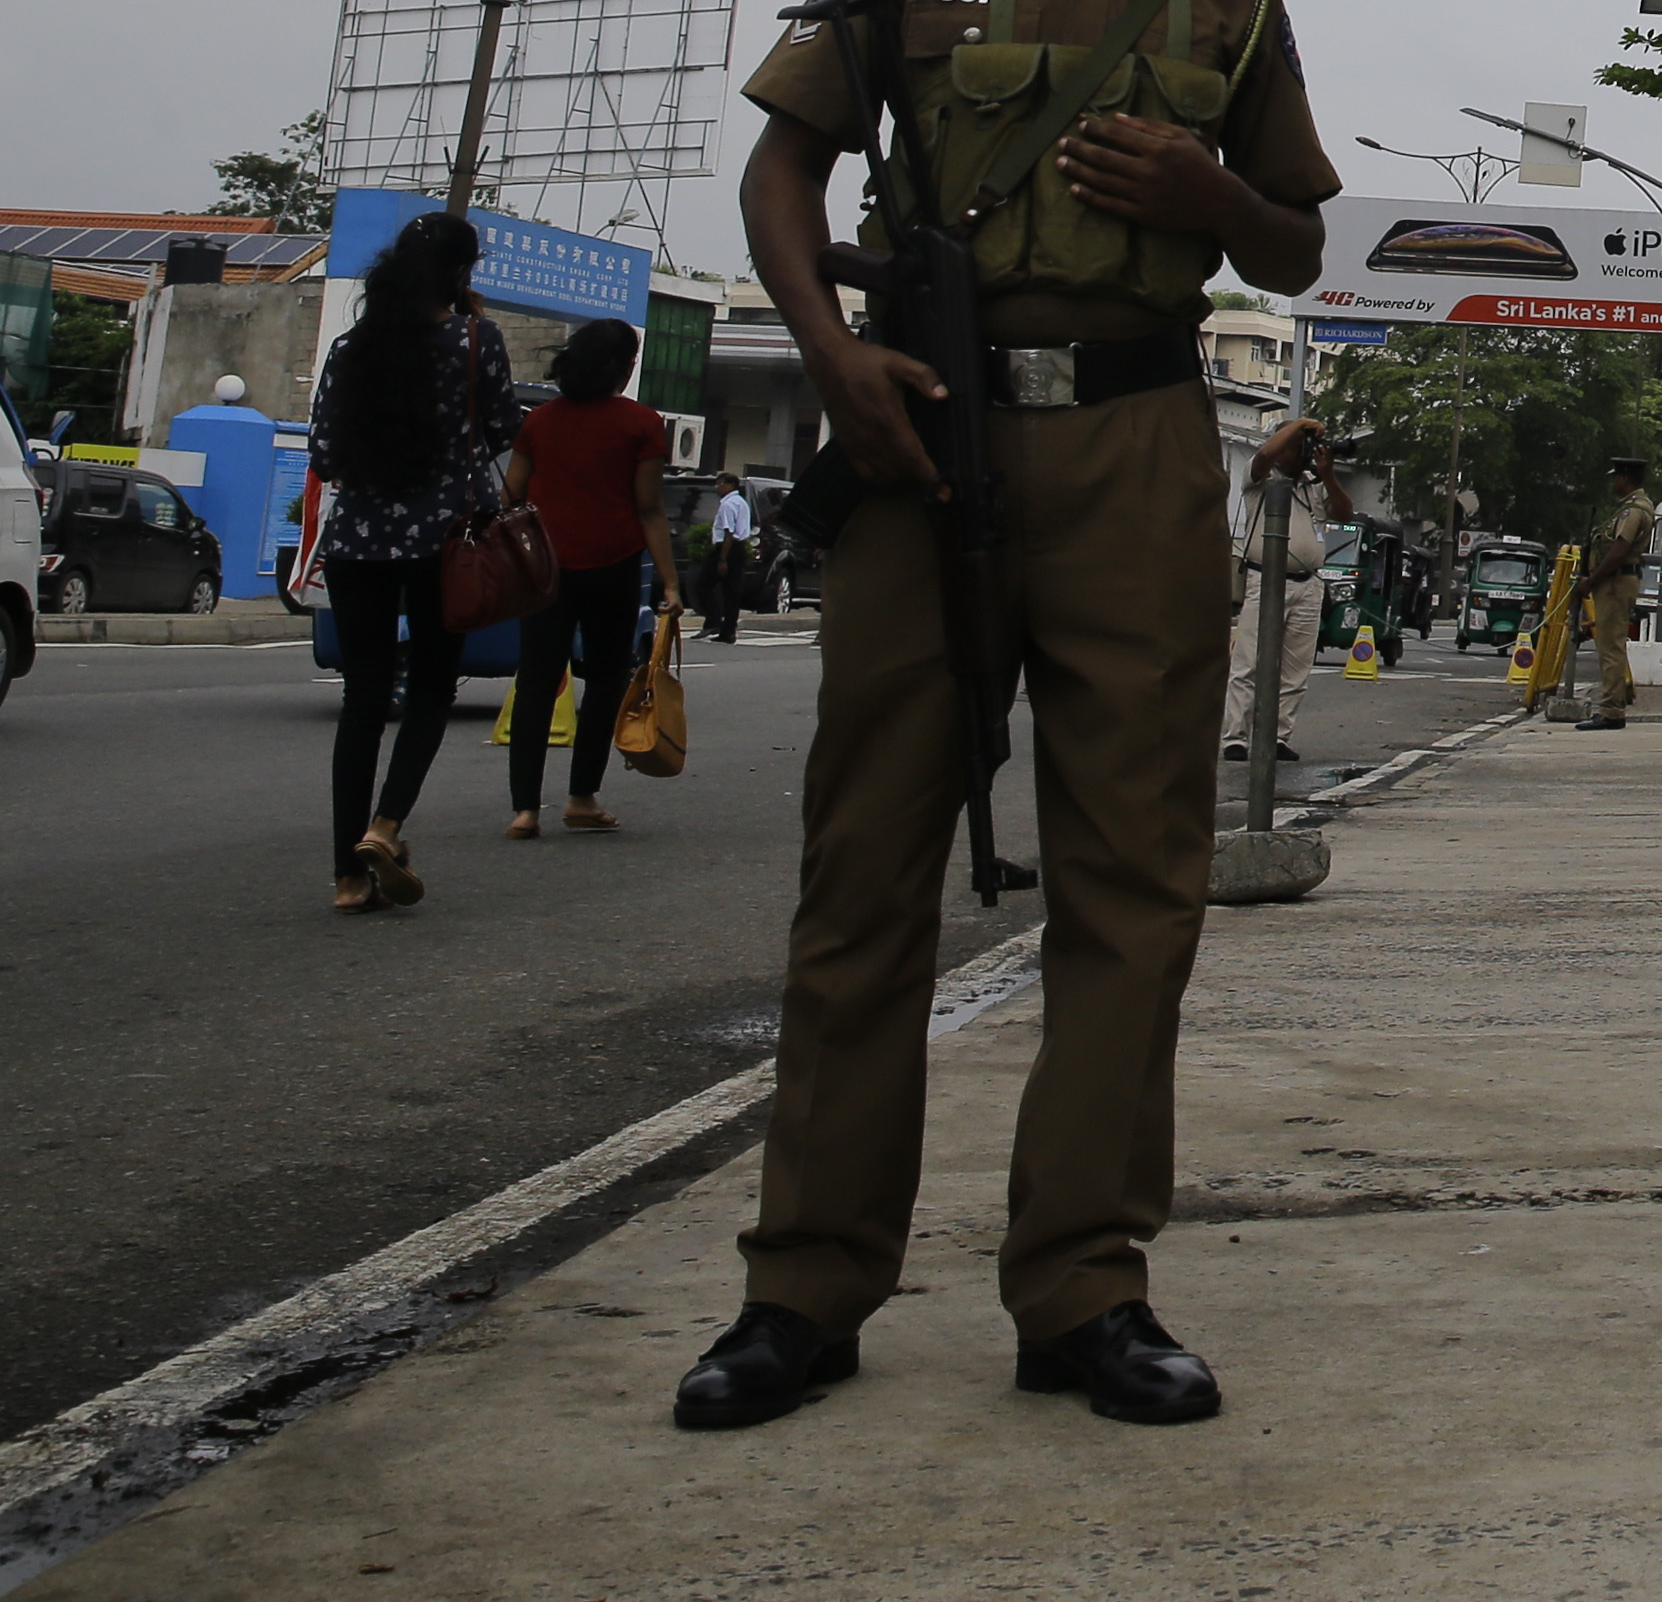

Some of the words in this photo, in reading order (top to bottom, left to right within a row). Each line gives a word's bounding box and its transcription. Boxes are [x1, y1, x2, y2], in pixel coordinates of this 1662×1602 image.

[1316, 291, 1355, 306] 4G
[1355, 297, 1415, 310] Powered
[1416, 300, 1434, 312] by
[1496, 300, 1524, 317] Sri
[1529, 302, 1607, 321] Lanka's
[1612, 305, 1635, 322] #1
[1325, 329, 1382, 339] RICHARDSON
